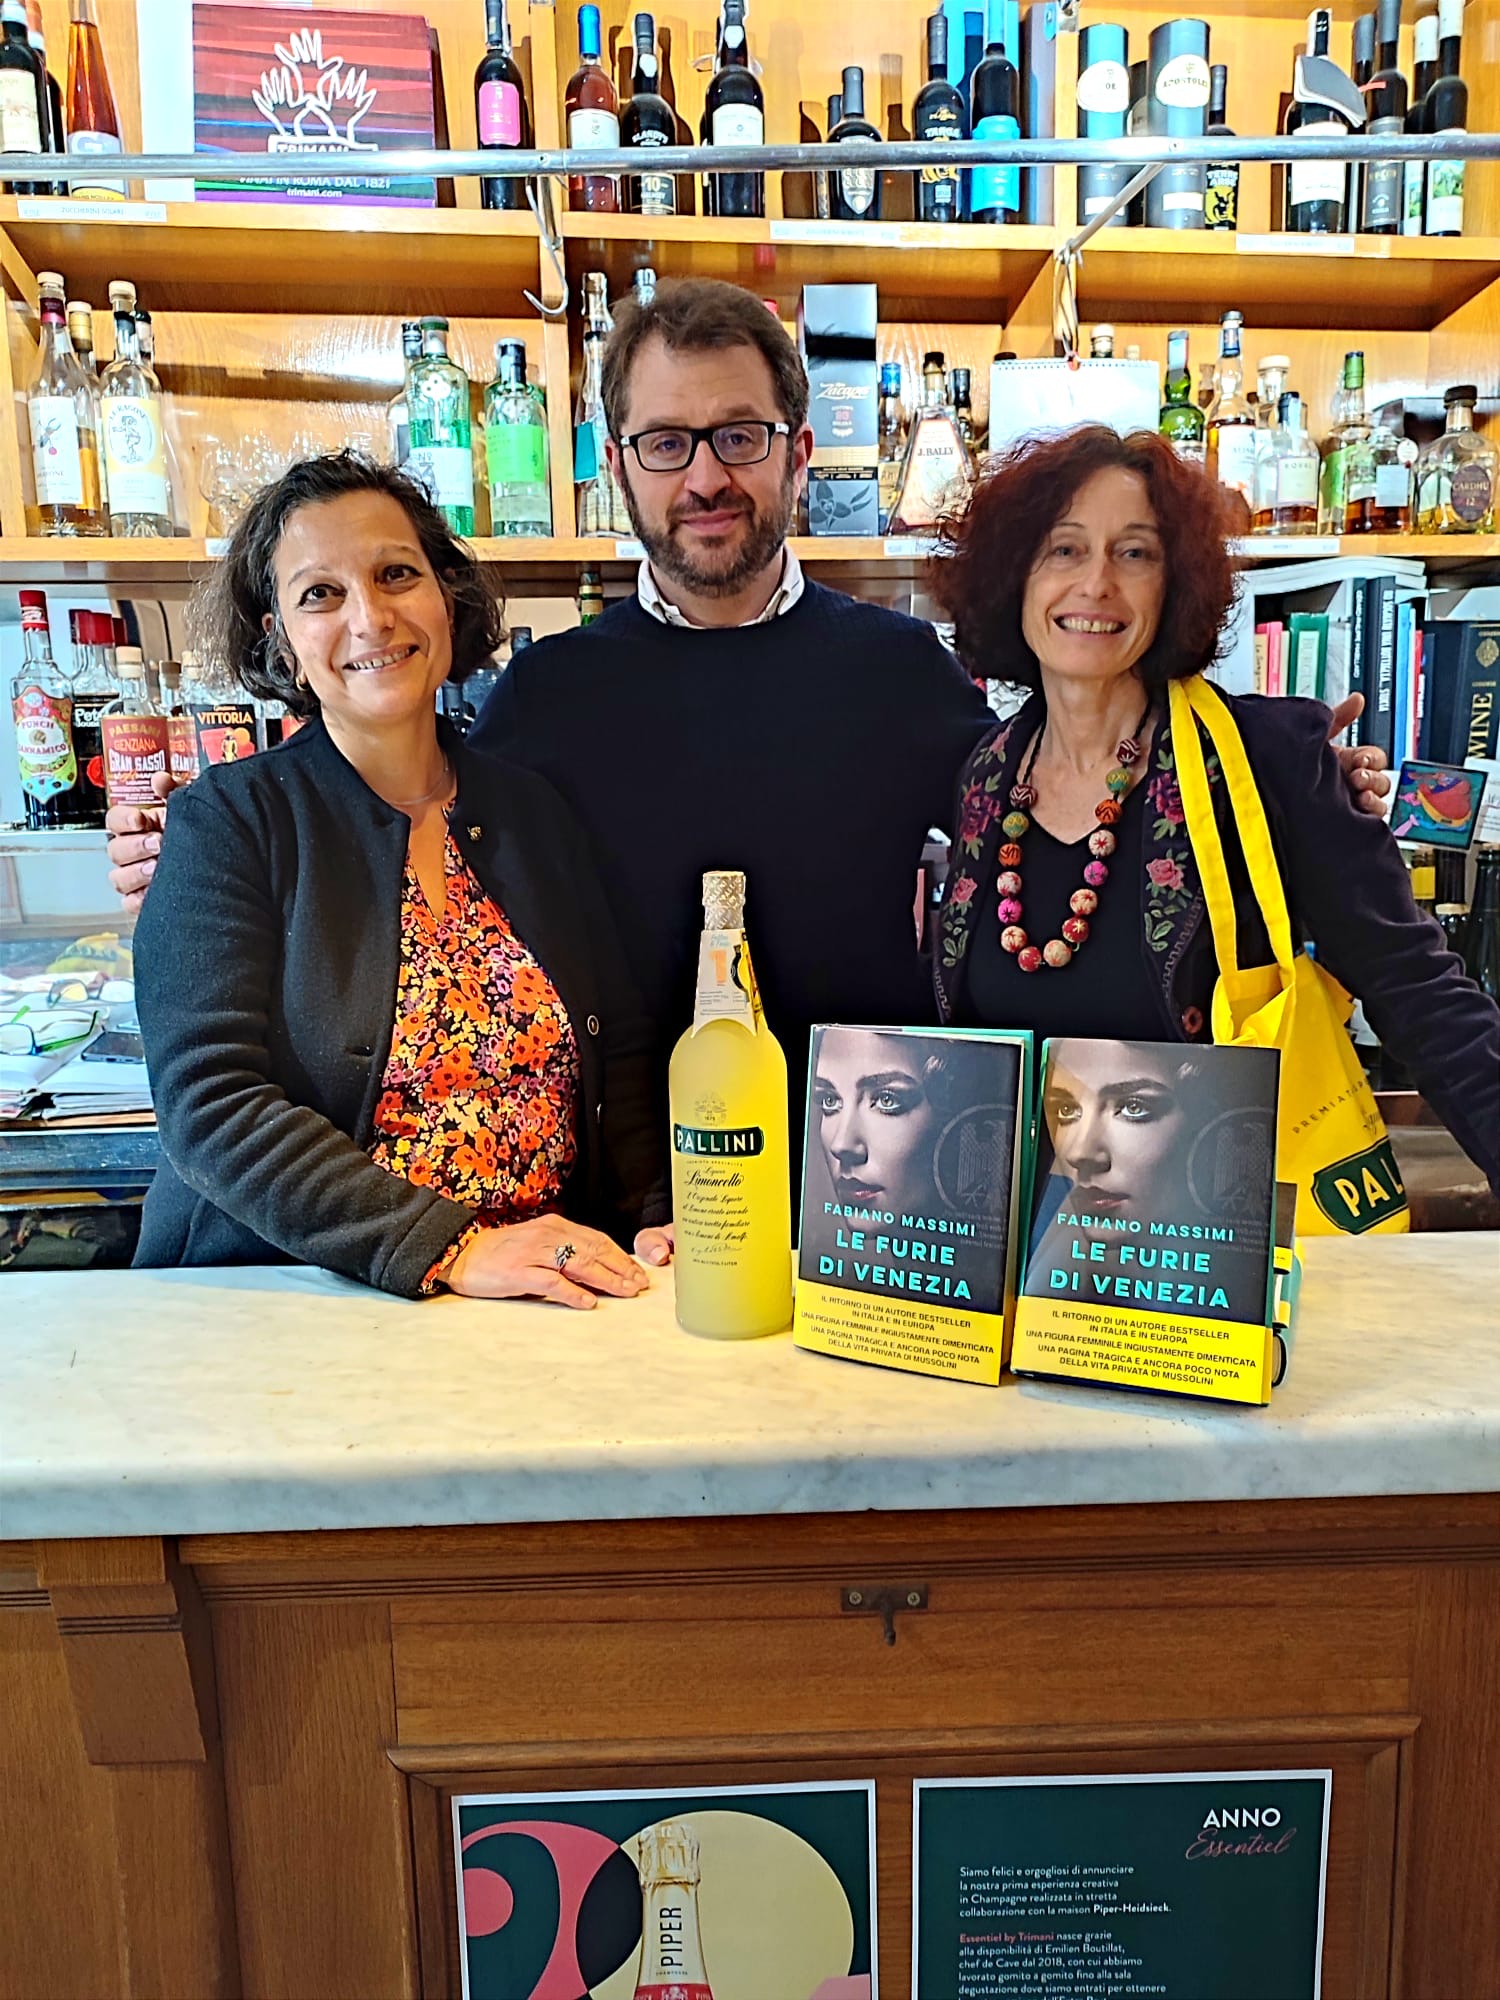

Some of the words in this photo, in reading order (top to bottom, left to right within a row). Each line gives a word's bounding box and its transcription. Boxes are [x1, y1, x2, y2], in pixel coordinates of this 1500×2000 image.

[287, 187, 342, 197] trimani.com
[293, 177, 331, 187] ROMA
[335, 177, 360, 187] DAL
[365, 177, 390, 189] 1821
[926, 447, 954, 456] BALLY
[1453, 482, 1489, 490] CARDHU
[197, 712, 253, 724] VITTORIA
[1467, 692, 1493, 759] WINE
[114, 738, 157, 751] GENZIANA
[109, 749, 132, 772] GRAN
[134, 749, 166, 771] SASSO
[676, 1129, 755, 1153] PALLINI
[684, 1170, 745, 1189] Limoncello
[824, 1202, 894, 1224] FABIANO
[901, 1214, 975, 1237] MASSIMI
[1057, 1213, 1141, 1233] FABIANO
[1150, 1222, 1233, 1242] MASSIMI
[836, 1229, 864, 1251] LE
[876, 1235, 954, 1266] FURIE
[1071, 1240, 1106, 1262] LE
[1119, 1245, 1210, 1273] FURIE
[819, 1256, 843, 1277] DI
[853, 1261, 971, 1300] VENEZIA
[1050, 1270, 1079, 1290] DI
[1092, 1274, 1229, 1308] VENEZIA
[829, 1296, 862, 1308] RITORNO
[884, 1307, 916, 1319] AUTORE
[918, 1312, 971, 1328] BESTSELLER
[860, 1312, 884, 1322] ITALIA
[902, 1319, 935, 1331] EUROPA
[801, 1311, 814, 1321] UNA
[815, 1314, 840, 1326] FIGURA
[841, 1318, 878, 1333] FEMMINILE
[880, 1328, 940, 1344] INGIUSTAMENTE
[942, 1338, 994, 1354] DIMENTICATA
[1052, 1310, 1059, 1318] IL
[1062, 1311, 1102, 1323] RITORNO
[1103, 1316, 1113, 1324] DI
[1114, 1318, 1128, 1326] UN
[1129, 1320, 1167, 1332] AUTORE
[1169, 1325, 1229, 1340] BESTSELLER
[1100, 1326, 1128, 1336] ITALIA
[1130, 1330, 1136, 1338] E
[1138, 1331, 1148, 1339] IN
[1150, 1332, 1188, 1344] EUROPA
[810, 1325, 824, 1335] UNA
[826, 1328, 853, 1340] PAGINA
[855, 1334, 888, 1347] TRAGICA
[896, 1343, 930, 1355] ANCORA
[931, 1349, 956, 1360] POCO
[956, 1353, 980, 1364] NOTA
[828, 1338, 851, 1350] DELLA
[853, 1343, 868, 1353] VITA
[870, 1346, 902, 1359] PRIVATA
[913, 1355, 957, 1369] MUSSOLINI
[1025, 1330, 1042, 1338] UNA
[1044, 1332, 1075, 1342] FIGURA
[1076, 1336, 1122, 1349] FEMMINILE
[1124, 1342, 1194, 1359] INGIUSTAMENTE
[1196, 1352, 1256, 1368] DIMENTICATA
[1038, 1344, 1056, 1352] UNA
[1057, 1347, 1090, 1358] PAGINA
[1092, 1351, 1132, 1364] TRAGICA
[1134, 1357, 1140, 1365] E
[1142, 1358, 1182, 1370] ANCORA
[1184, 1364, 1212, 1375] POCO
[1214, 1368, 1240, 1379] NOTA
[1059, 1357, 1088, 1367] DELLA
[1090, 1361, 1110, 1370] VITA
[1111, 1364, 1148, 1376] PRIVATA
[1150, 1369, 1160, 1377] DI
[1162, 1371, 1213, 1385] MUSSOLINI
[1202, 1808, 1281, 1828] ANNO
[1185, 1827, 1297, 1860] Essentiel
[959, 1867, 989, 1877] Siamo
[991, 1866, 1014, 1876] felici
[1016, 1868, 1022, 1876] e
[1024, 1865, 1069, 1879] orgogliosi
[1071, 1865, 1080, 1875] di
[1082, 1864, 1134, 1874] annunciare
[959, 1880, 968, 1890] la
[970, 1882, 1000, 1890] nostra
[1001, 1879, 1029, 1892] prima
[1031, 1879, 1080, 1892] esperienza
[1081, 1879, 1119, 1888] creativa
[959, 1894, 969, 1904] in
[970, 1893, 1028, 1906] Champagne
[1029, 1892, 1072, 1902] realizzata
[1074, 1892, 1083, 1901] in
[1086, 1892, 1117, 1902] stretta
[959, 1906, 1026, 1917] collaborazione
[1047, 1905, 1055, 1914] la
[1093, 1902, 1171, 1916] Piper-Heidsieck.
[659, 1907, 683, 1967] PIPER
[959, 1932, 1002, 1943] Essentiel
[1004, 1932, 1016, 1944] by
[1018, 1931, 1054, 1942] Trimani
[1083, 1931, 1113, 1944] grazie
[959, 1946, 974, 1956] alla
[976, 1945, 1032, 1958] disponibilità
[1033, 1945, 1043, 1954] di
[1045, 1944, 1080, 1954] Emilien
[1082, 1943, 1125, 1957] Boutillat,
[958, 1958, 980, 1969] chef
[981, 1958, 993, 1968] de
[995, 1958, 1020, 1968] Cave
[1021, 1957, 1036, 1967] dal
[1038, 1957, 1065, 1968] 2018,
[1087, 1956, 1101, 1966] cui
[1103, 1956, 1143, 1966] abbiamo
[958, 1972, 996, 1981] lavorato
[997, 1971, 1031, 1984] gomito
[1033, 1972, 1038, 1980] a
[1040, 1970, 1074, 1983] gomito
[1076, 1970, 1095, 1979] fino
[1096, 1970, 1112, 1979] alla
[1114, 1969, 1131, 1979] sala
[958, 1984, 1018, 1997] degustazione
[1020, 1983, 1043, 1994] dove
[1045, 1983, 1072, 1994] siamo
[1074, 1982, 1105, 1993] entrati
[1107, 1985, 1123, 1995] per
[1125, 1984, 1166, 1993] ottenere
